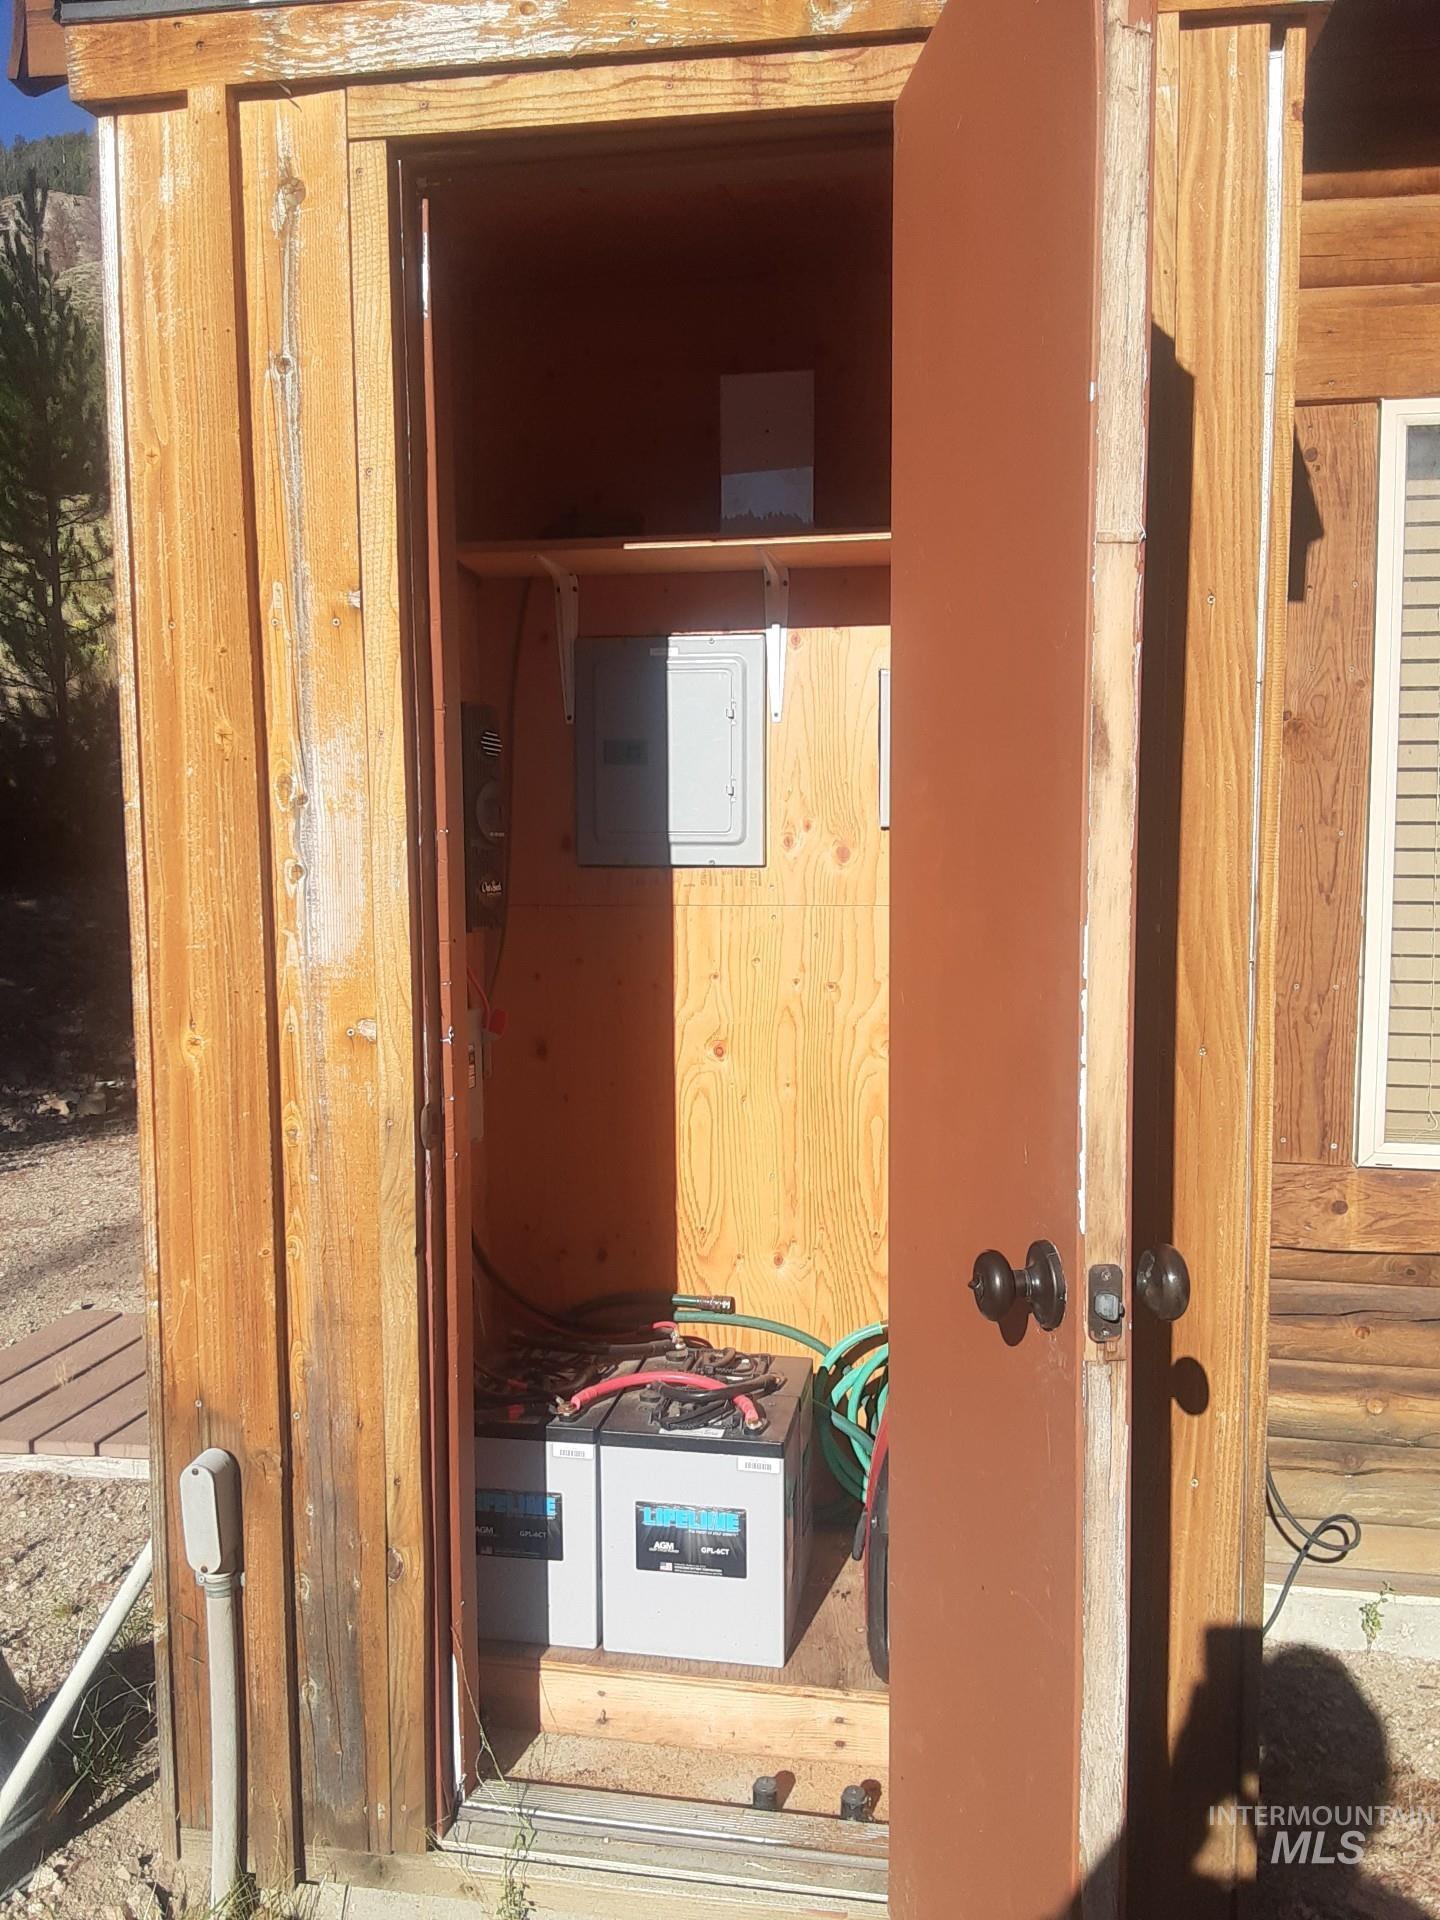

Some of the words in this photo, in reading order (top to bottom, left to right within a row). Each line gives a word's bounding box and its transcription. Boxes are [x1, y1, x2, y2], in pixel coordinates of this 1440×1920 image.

[476, 1493, 557, 1516] IFELINE
[641, 1506, 741, 1532] LIFELINE
[653, 1541, 675, 1550] AGM
[700, 1546, 730, 1556] GPL-6CT
